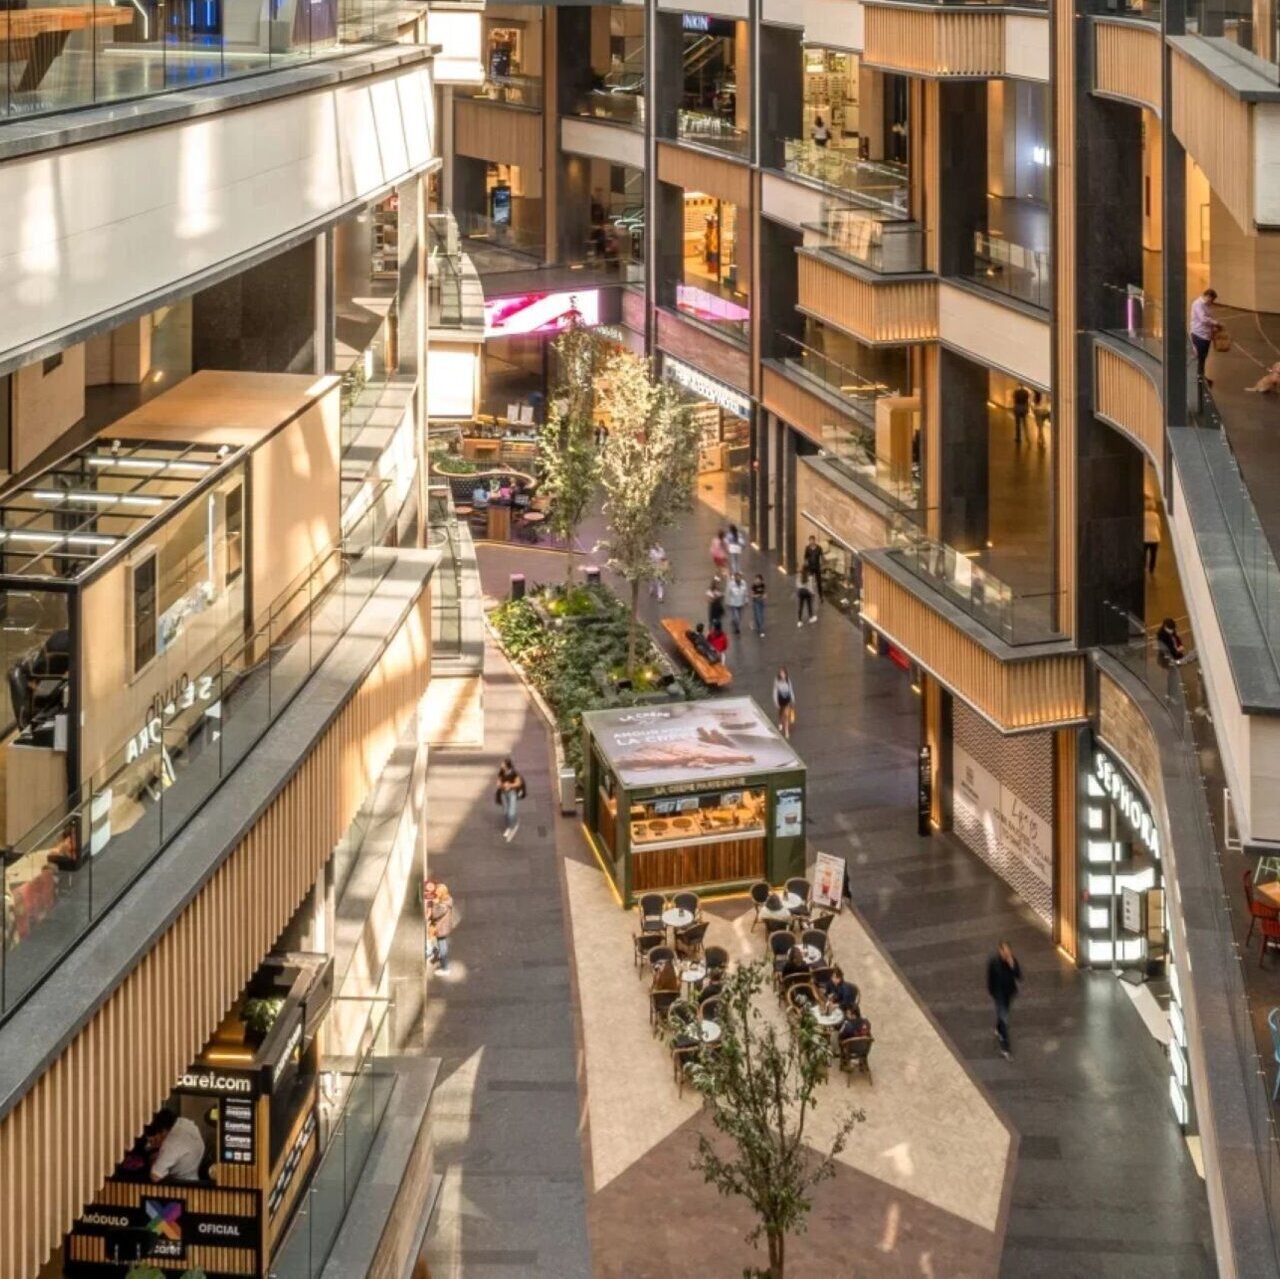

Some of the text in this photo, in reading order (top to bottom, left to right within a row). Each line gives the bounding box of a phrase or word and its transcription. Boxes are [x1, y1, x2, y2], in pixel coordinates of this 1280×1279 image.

[1096, 753, 1161, 859] SEPHORA
[82, 1212, 240, 1236] MÓDULO OFICIAL
